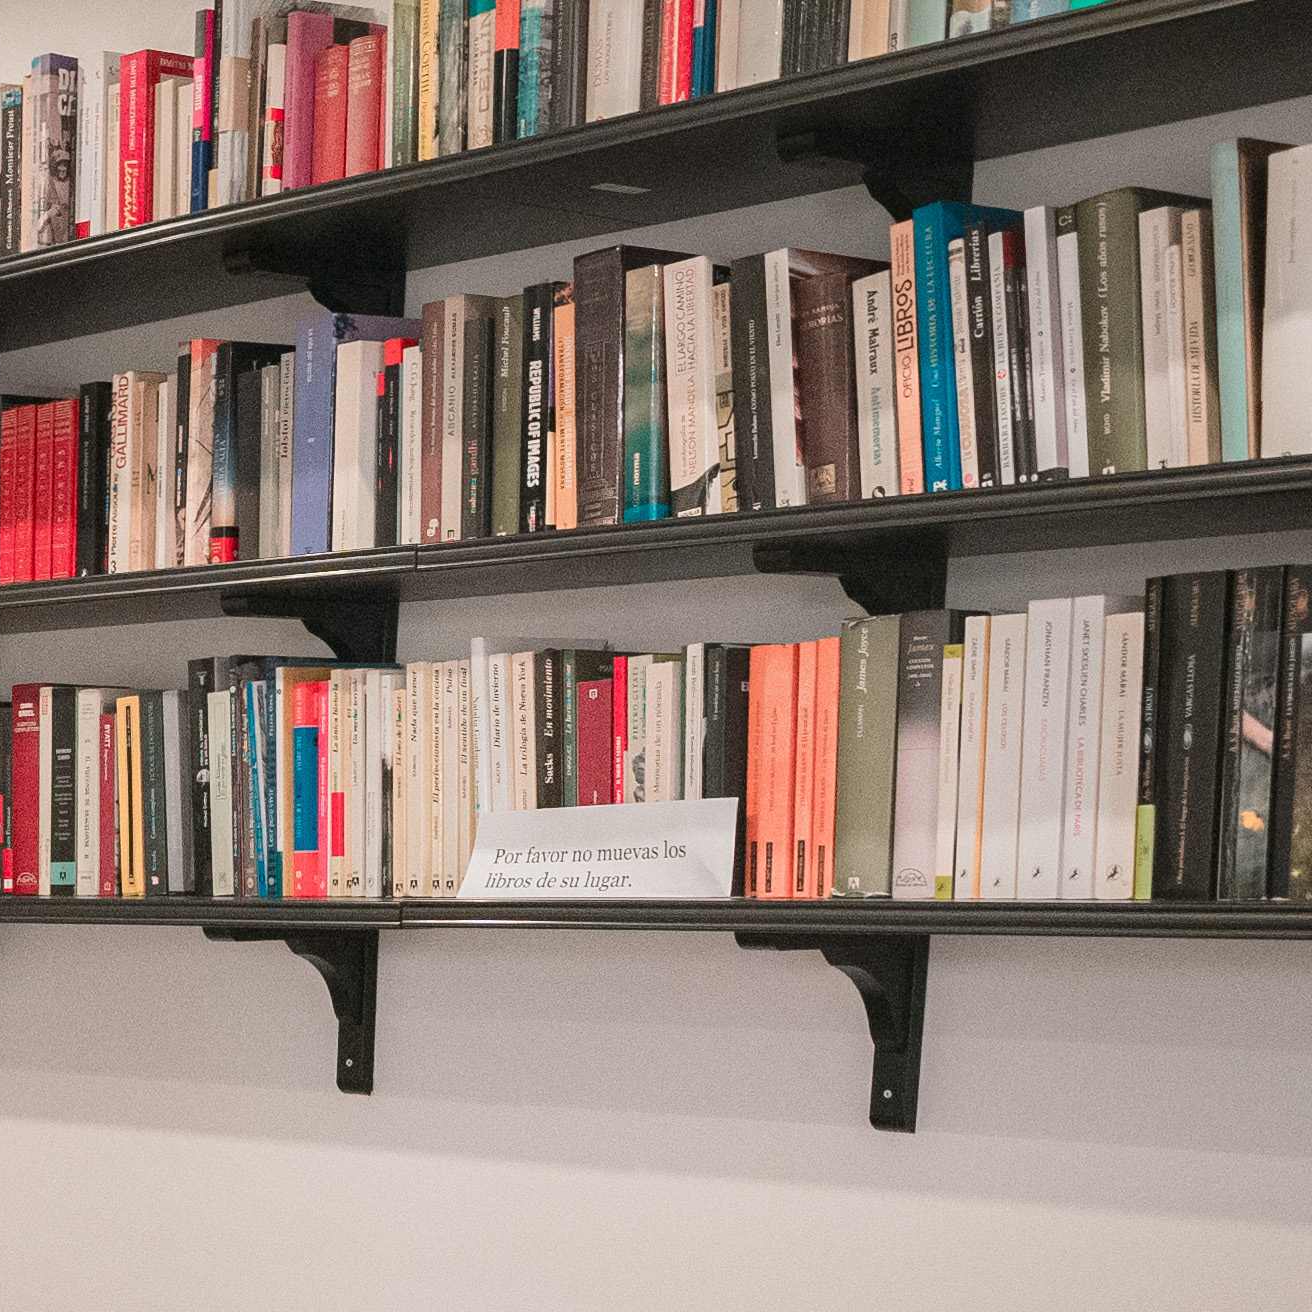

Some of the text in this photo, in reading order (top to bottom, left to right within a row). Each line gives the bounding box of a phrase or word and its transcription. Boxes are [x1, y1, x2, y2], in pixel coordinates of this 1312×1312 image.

[4, 108, 16, 184] Monsieur Proust
[675, 269, 686, 319] CAMINO
[685, 267, 696, 316] LIBERTAD
[866, 290, 879, 324] André
[969, 229, 984, 338] Carrión Librerías
[1095, 201, 1112, 402] Vladimir Nabokov (Los años rusos)
[499, 305, 512, 377] Michel Foucault
[676, 320, 687, 360] LARGO
[686, 338, 697, 370] HACIA
[868, 328, 880, 376] Malraux
[895, 278, 915, 398] OFICIO LIBROS
[526, 307, 543, 488] WILLIAMS REPUBLIC OF IMAGES
[1190, 374, 1203, 422] HISTORIA
[116, 375, 129, 469] GALLIMARD
[631, 451, 641, 485] norma
[1081, 619, 1091, 646] JANET
[1119, 632, 1129, 668] SÁNDOR
[492, 662, 500, 702] invierno
[856, 625, 870, 692] James Joyce
[1041, 620, 1053, 707] JONATHAN FRANZEN
[1080, 647, 1090, 687] SKESLIEN
[1077, 688, 1088, 727] CHARLES
[1118, 670, 1128, 698] MÁRAI
[1184, 654, 1196, 718] VARGAS LLOSA
[492, 722, 501, 748] Diario
[517, 660, 529, 776] La trilogía de Nueva York
[543, 657, 554, 784] Sacks En movimiento
[1077, 738, 1085, 749] LA
[1074, 750, 1085, 799] BIBLIOTECA
[1073, 800, 1082, 812] DE
[493, 840, 687, 865] Por favor no muevas los
[484, 871, 633, 892] libros de su lugar.
